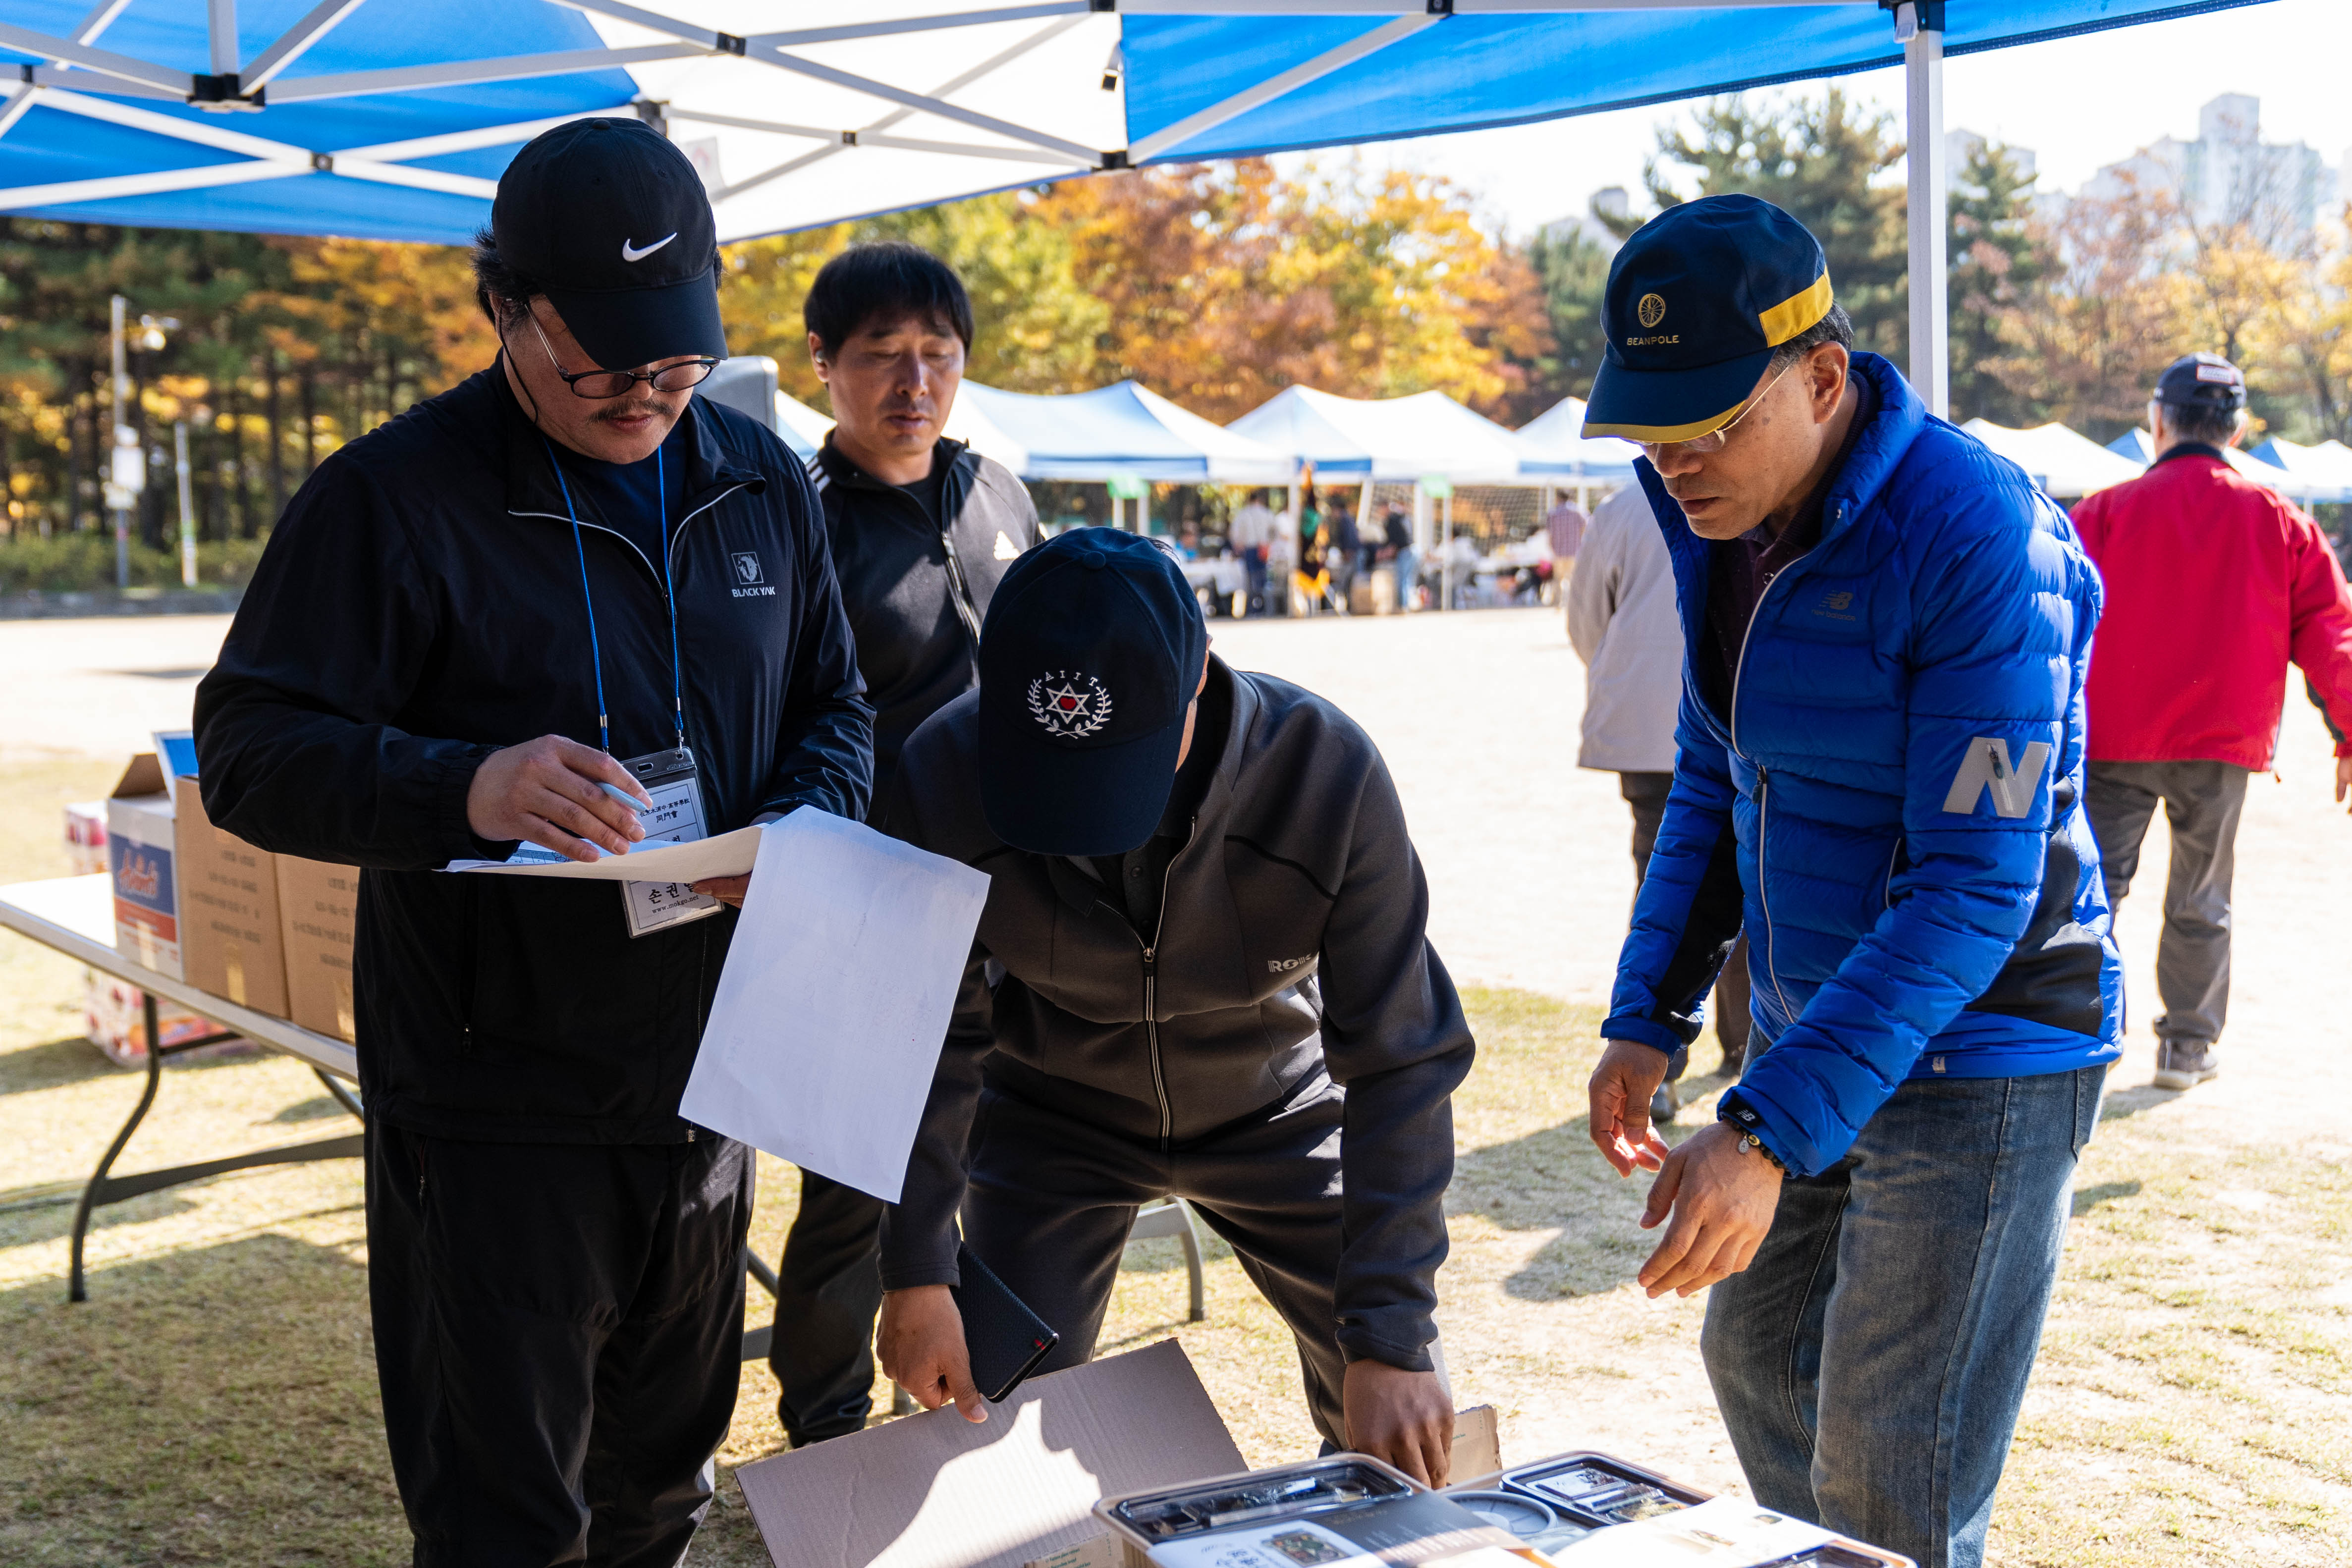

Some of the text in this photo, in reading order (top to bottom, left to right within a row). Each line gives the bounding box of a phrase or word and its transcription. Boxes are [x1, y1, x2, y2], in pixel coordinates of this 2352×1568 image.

[1627, 335, 1680, 346] BEANPOLE
[731, 586, 775, 597] BLACK YAK
[652, 895, 699, 914] www.mokgo.net
